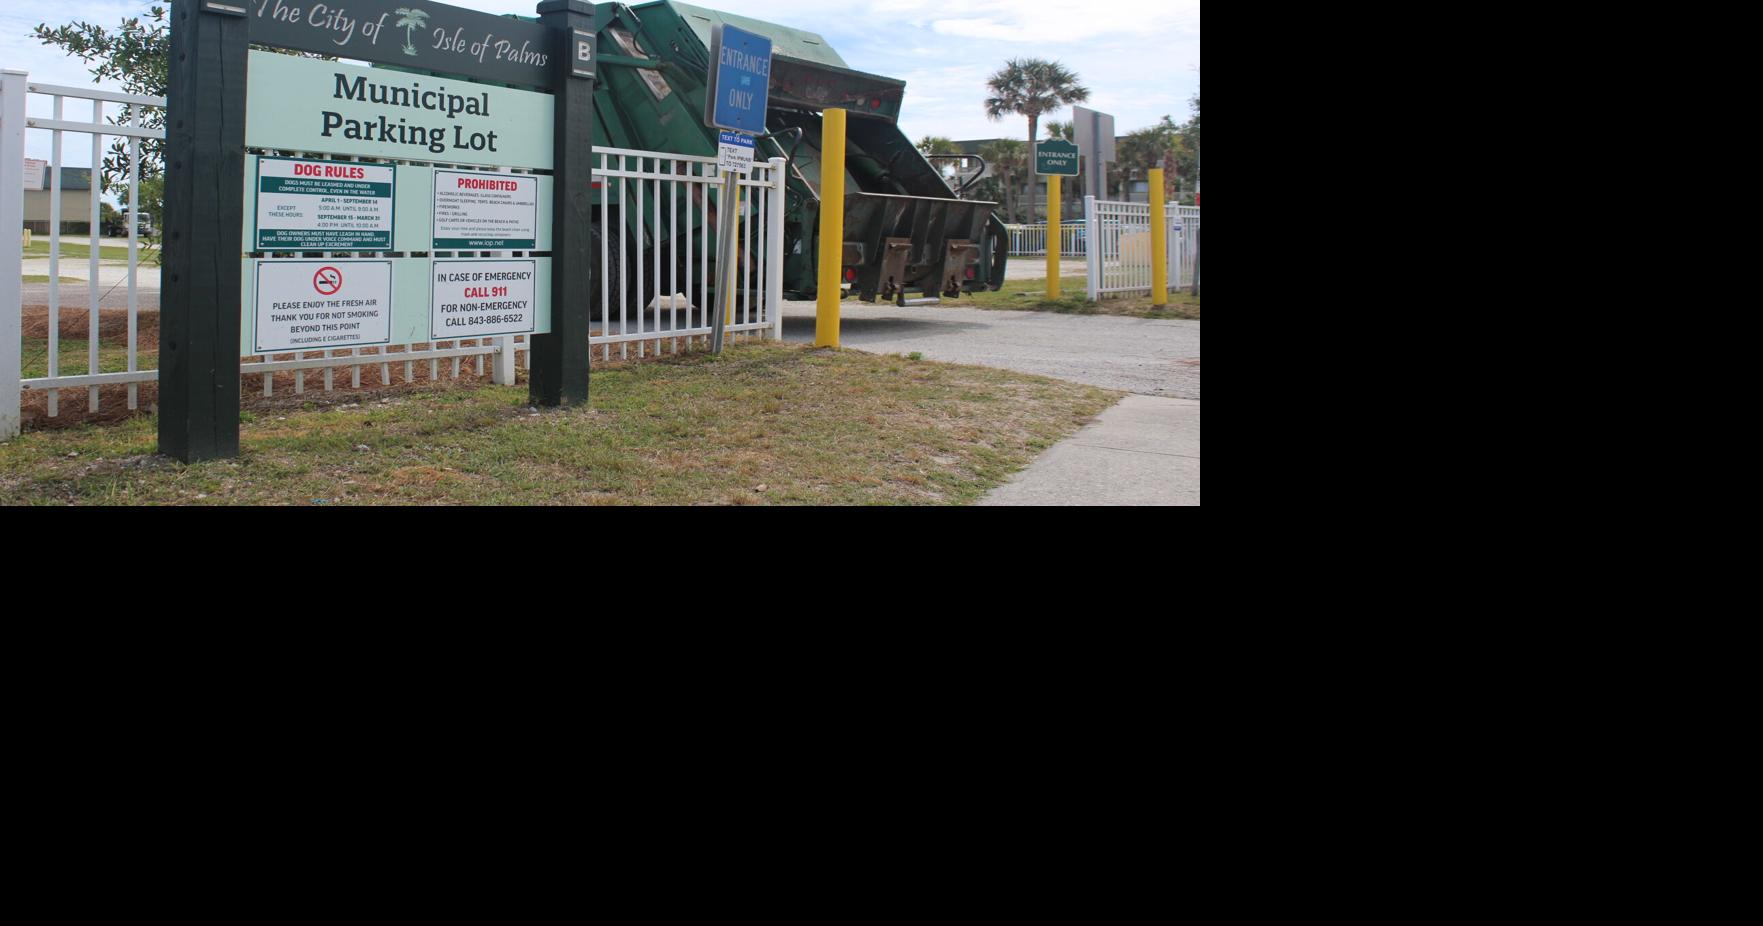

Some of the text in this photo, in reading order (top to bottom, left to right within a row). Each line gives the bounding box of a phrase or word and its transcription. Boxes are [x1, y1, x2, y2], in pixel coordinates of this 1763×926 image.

[308, 4, 354, 45] City
[362, 12, 389, 44] of
[432, 27, 548, 66] Isle of Palms
[578, 41, 591, 61] B
[720, 47, 769, 76] ENTRANCE
[333, 73, 489, 119] Municipal
[729, 88, 754, 110] ONLY
[321, 111, 498, 153] Parking Lot
[294, 164, 364, 179] DOG RULES
[458, 178, 517, 191] PROHIBITED
[449, 273, 470, 281] CASE
[472, 273, 482, 281] OF
[485, 272, 531, 280] EMERGENCY
[464, 286, 507, 298] CALL 911
[441, 301, 527, 313] FOR NON-EMERGENCY
[446, 314, 522, 326] CALL 843-886-6522
